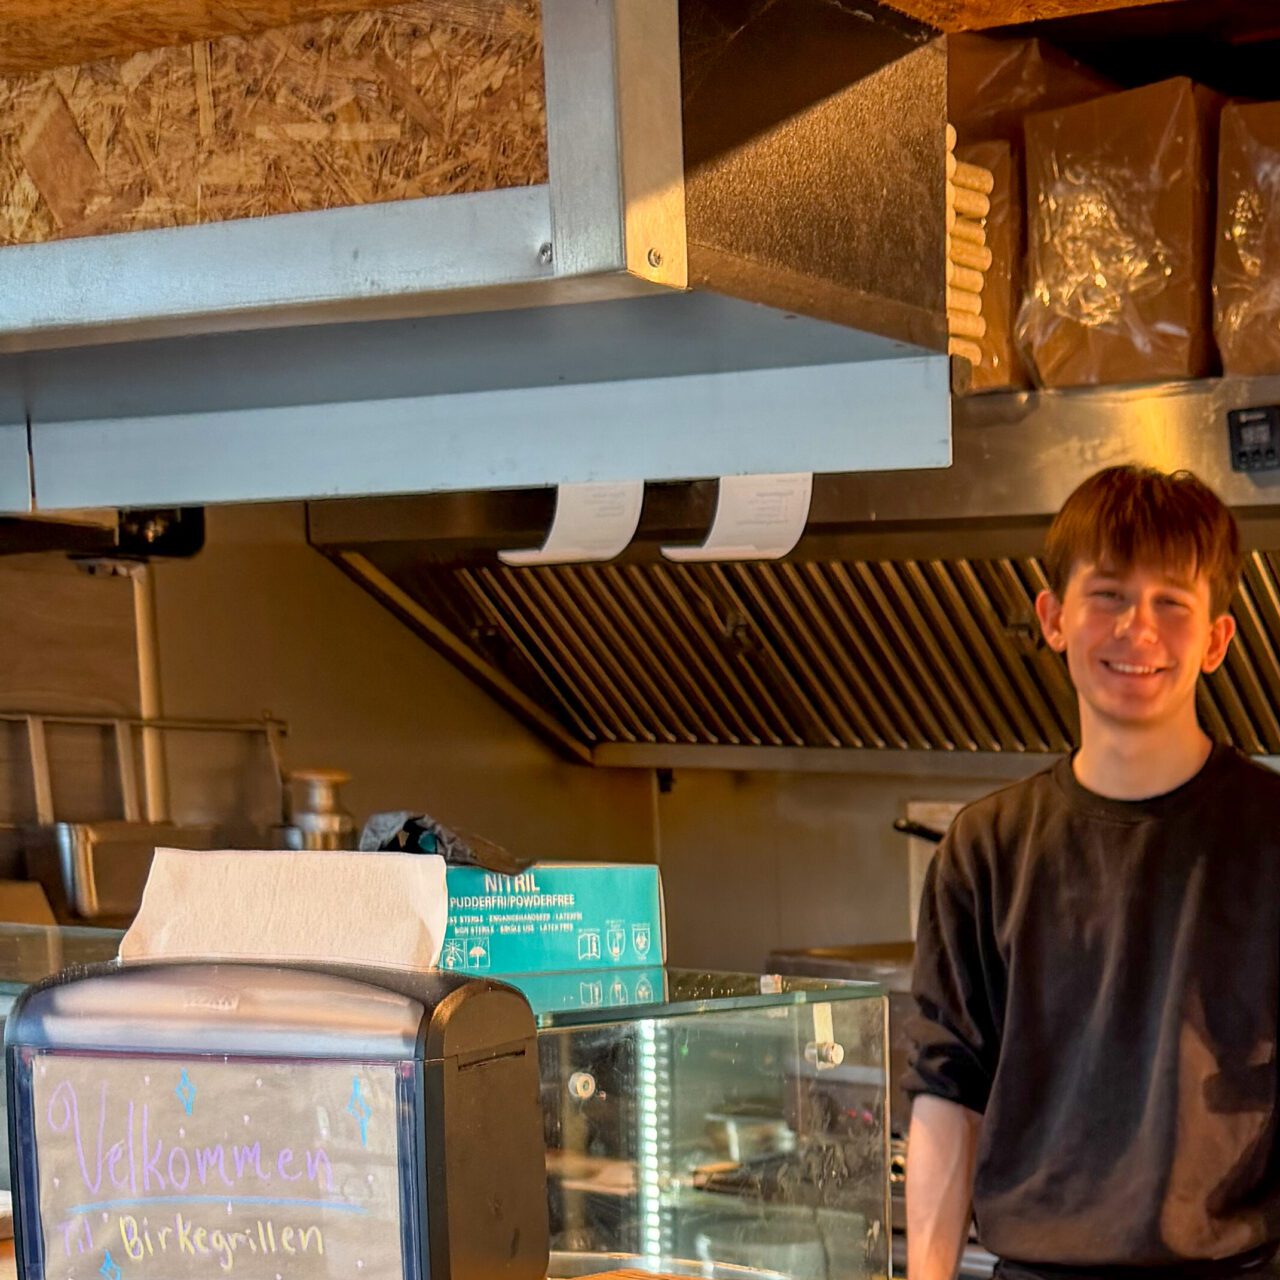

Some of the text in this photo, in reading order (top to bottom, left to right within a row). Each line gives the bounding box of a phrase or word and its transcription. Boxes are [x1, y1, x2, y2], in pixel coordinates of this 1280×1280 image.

[484, 873, 541, 893] NITRIL
[47, 1080, 335, 1195] Velkommen
[119, 1212, 324, 1272] Birkegrillen
